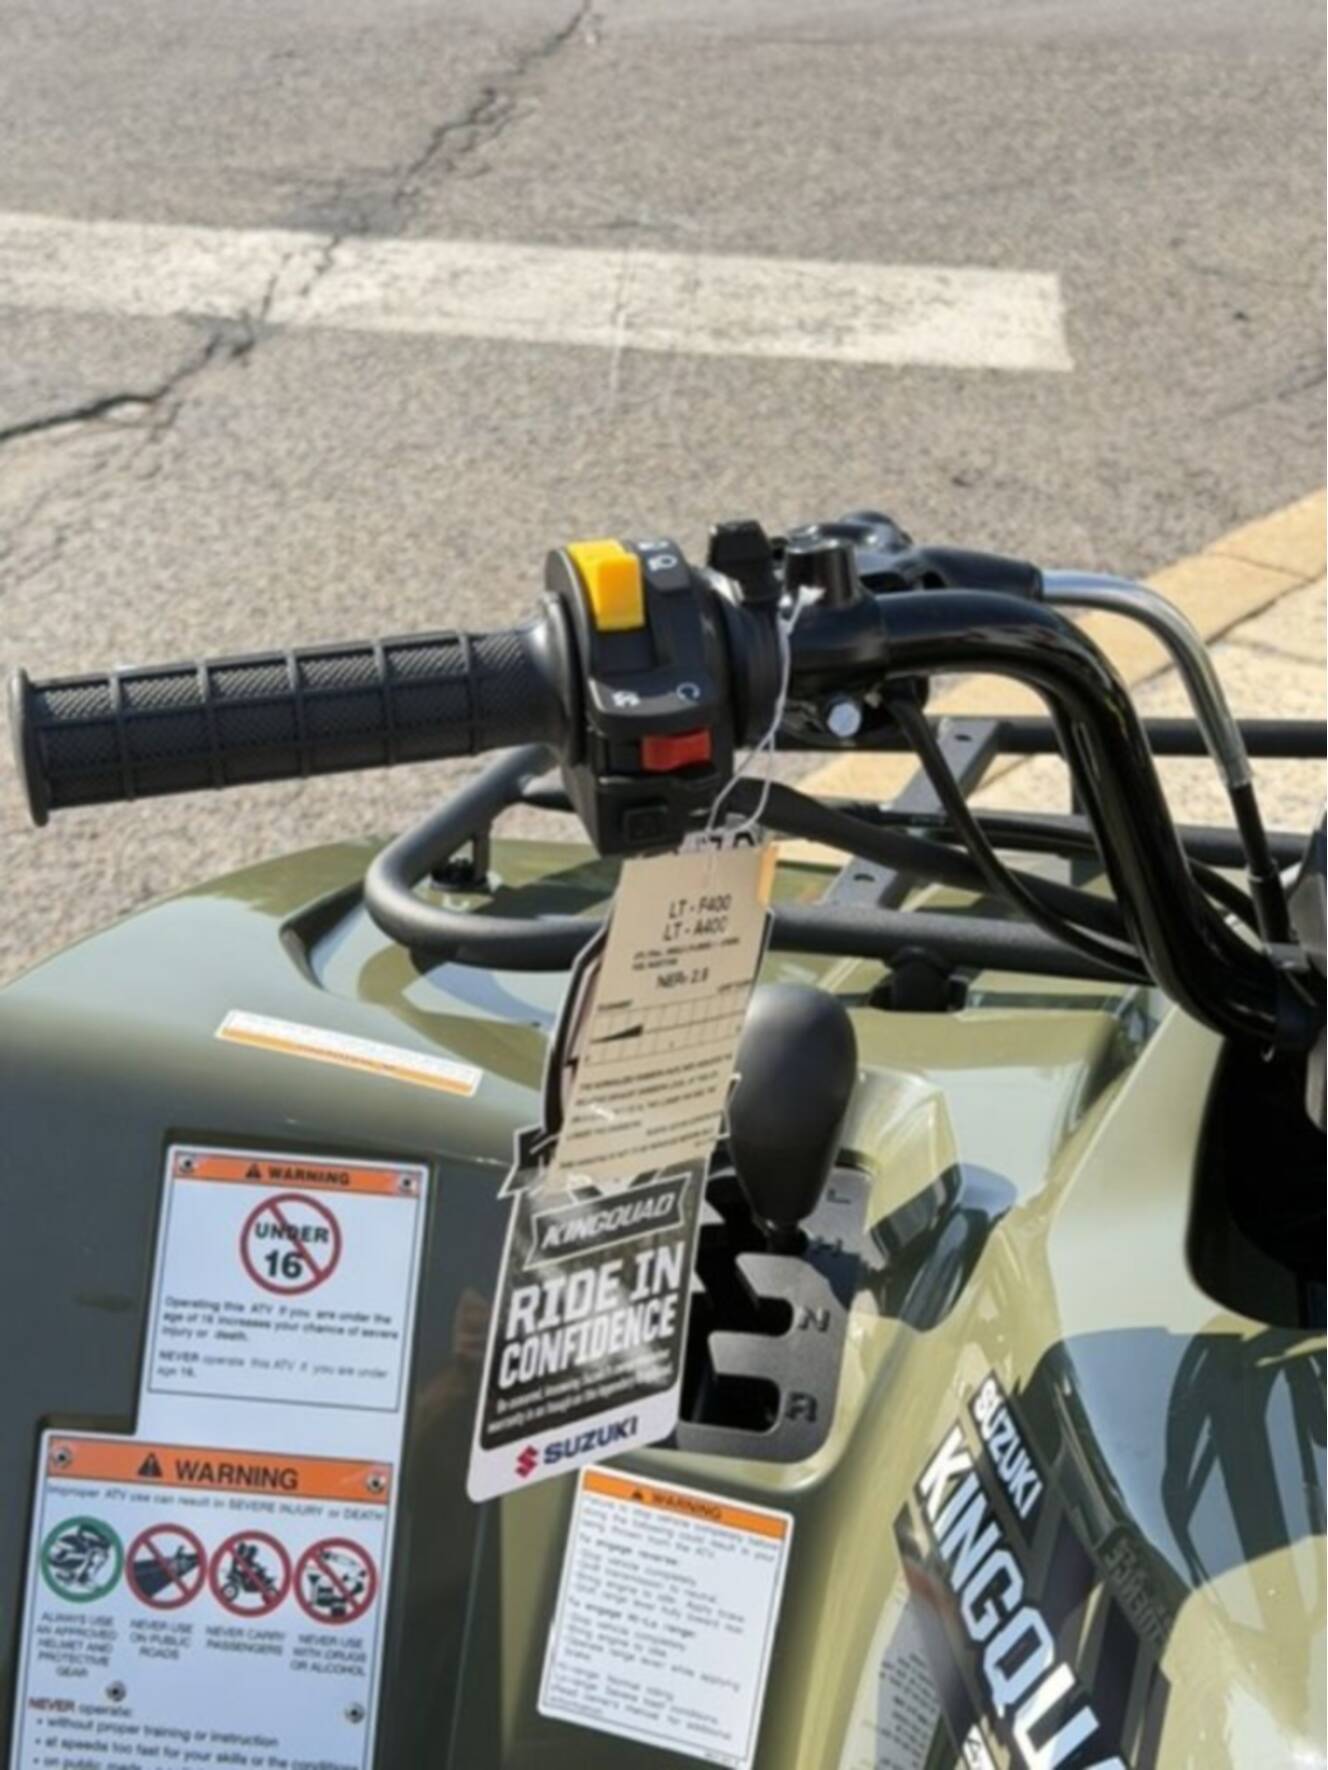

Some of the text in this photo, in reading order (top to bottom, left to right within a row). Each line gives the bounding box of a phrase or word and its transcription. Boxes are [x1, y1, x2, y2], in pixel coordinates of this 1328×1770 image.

[268, 1166, 350, 1186] WARNING
[255, 1222, 329, 1244] UNDER
[265, 1249, 303, 1279] 16
[505, 1241, 685, 1340] RIDE IN
[251, 1302, 272, 1314] ATV
[797, 1305, 831, 1332] N
[498, 1294, 678, 1389] CONFIDENCE
[159, 1350, 199, 1363] NEVER
[786, 1391, 818, 1424] R
[543, 1416, 638, 1465] SUZUKI
[972, 1377, 1044, 1521] SUZUKI
[175, 1459, 299, 1491] WARNING
[229, 1498, 274, 1513] SEVERE
[650, 1493, 722, 1520] WARNING
[918, 1425, 1130, 1770] KINGQU
[42, 1612, 114, 1628] ALWAYS USE
[130, 1618, 193, 1634] NEVER USE
[55, 1627, 118, 1641] APPROVED
[129, 1631, 191, 1648] ON PUBLIC
[205, 1625, 285, 1642] NEVER CARRY
[298, 1633, 364, 1649] NEVER USE
[37, 1638, 113, 1654] HELMET AND
[138, 1645, 180, 1660] ROADS
[206, 1638, 284, 1656] PASSENGERS
[37, 1650, 110, 1668] PROTECTIVE
[292, 1647, 367, 1664] WITH DRUGS
[55, 1665, 89, 1678] GEAR
[289, 1659, 366, 1678] OR ALCOHOL
[28, 1697, 76, 1713] NEVER
[47, 1716, 279, 1748] without proper training or instruction
[61, 1738, 109, 1754] speeds
[112, 1742, 133, 1755] too
[136, 1743, 161, 1757] fast
[164, 1746, 182, 1760] for
[184, 1749, 212, 1766] your
[216, 1751, 248, 1766] skills
[267, 1756, 288, 1769] the
